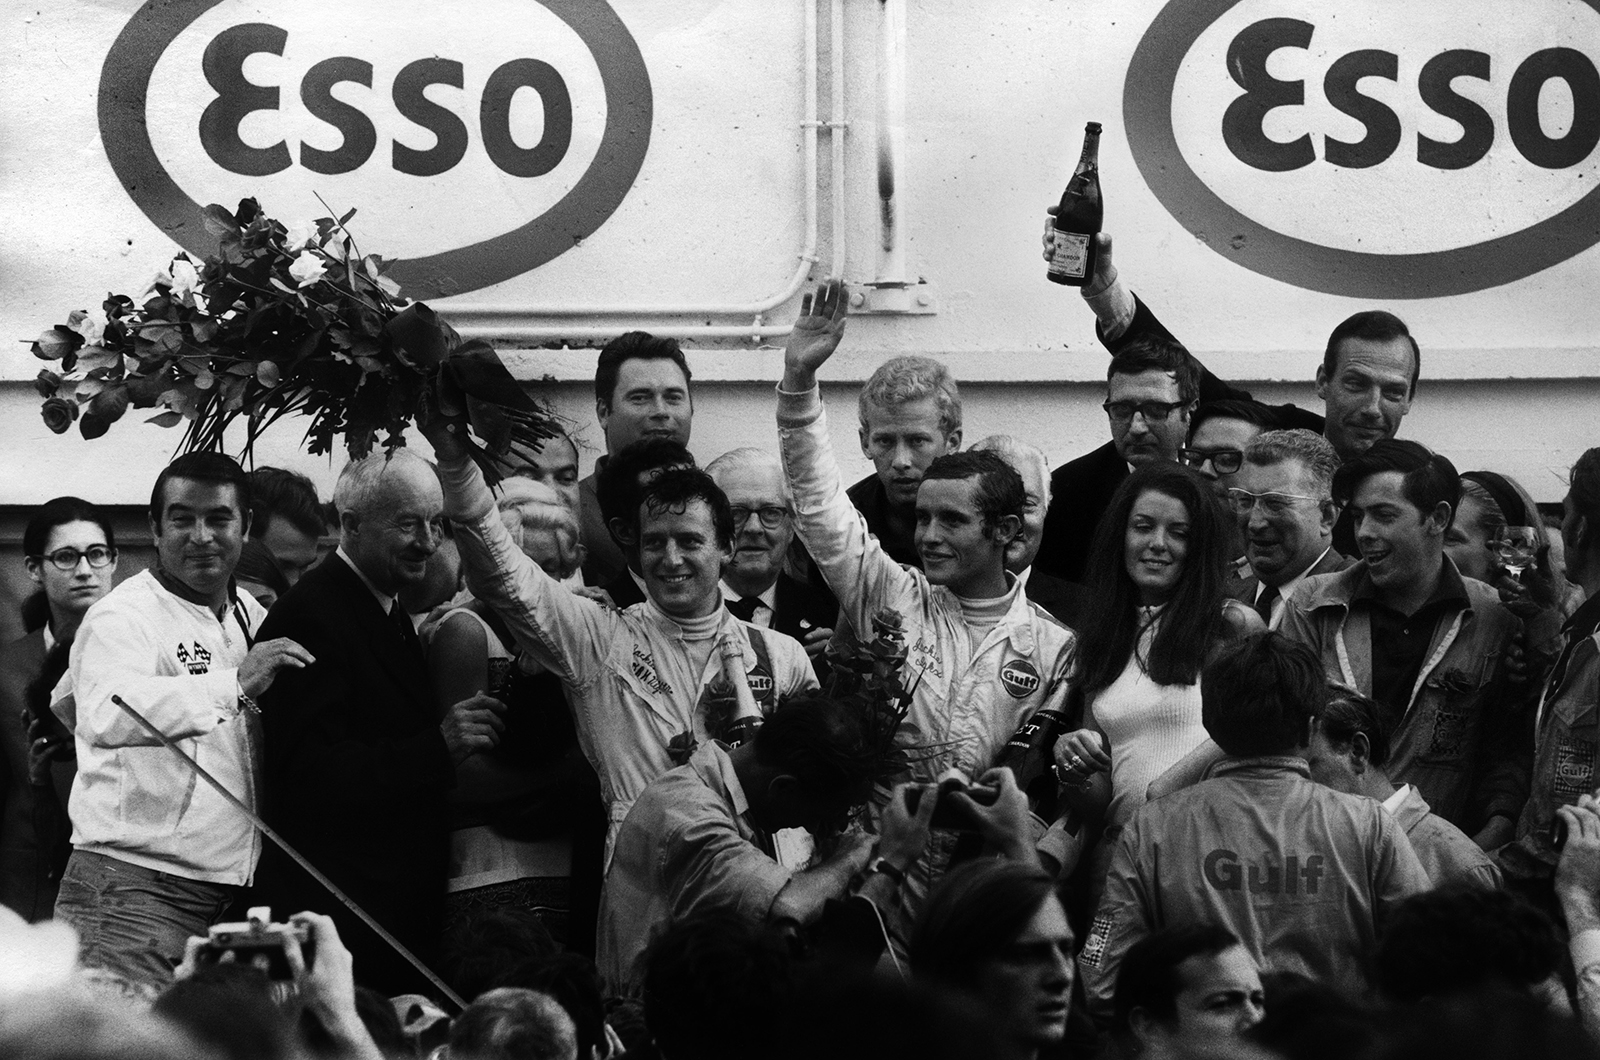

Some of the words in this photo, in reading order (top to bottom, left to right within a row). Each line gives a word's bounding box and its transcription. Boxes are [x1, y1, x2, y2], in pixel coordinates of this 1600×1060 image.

[747, 678, 772, 690] ulf
[1002, 668, 1038, 690] Gulf
[1561, 764, 1589, 777] Gulf
[1204, 849, 1324, 895] Gulf
